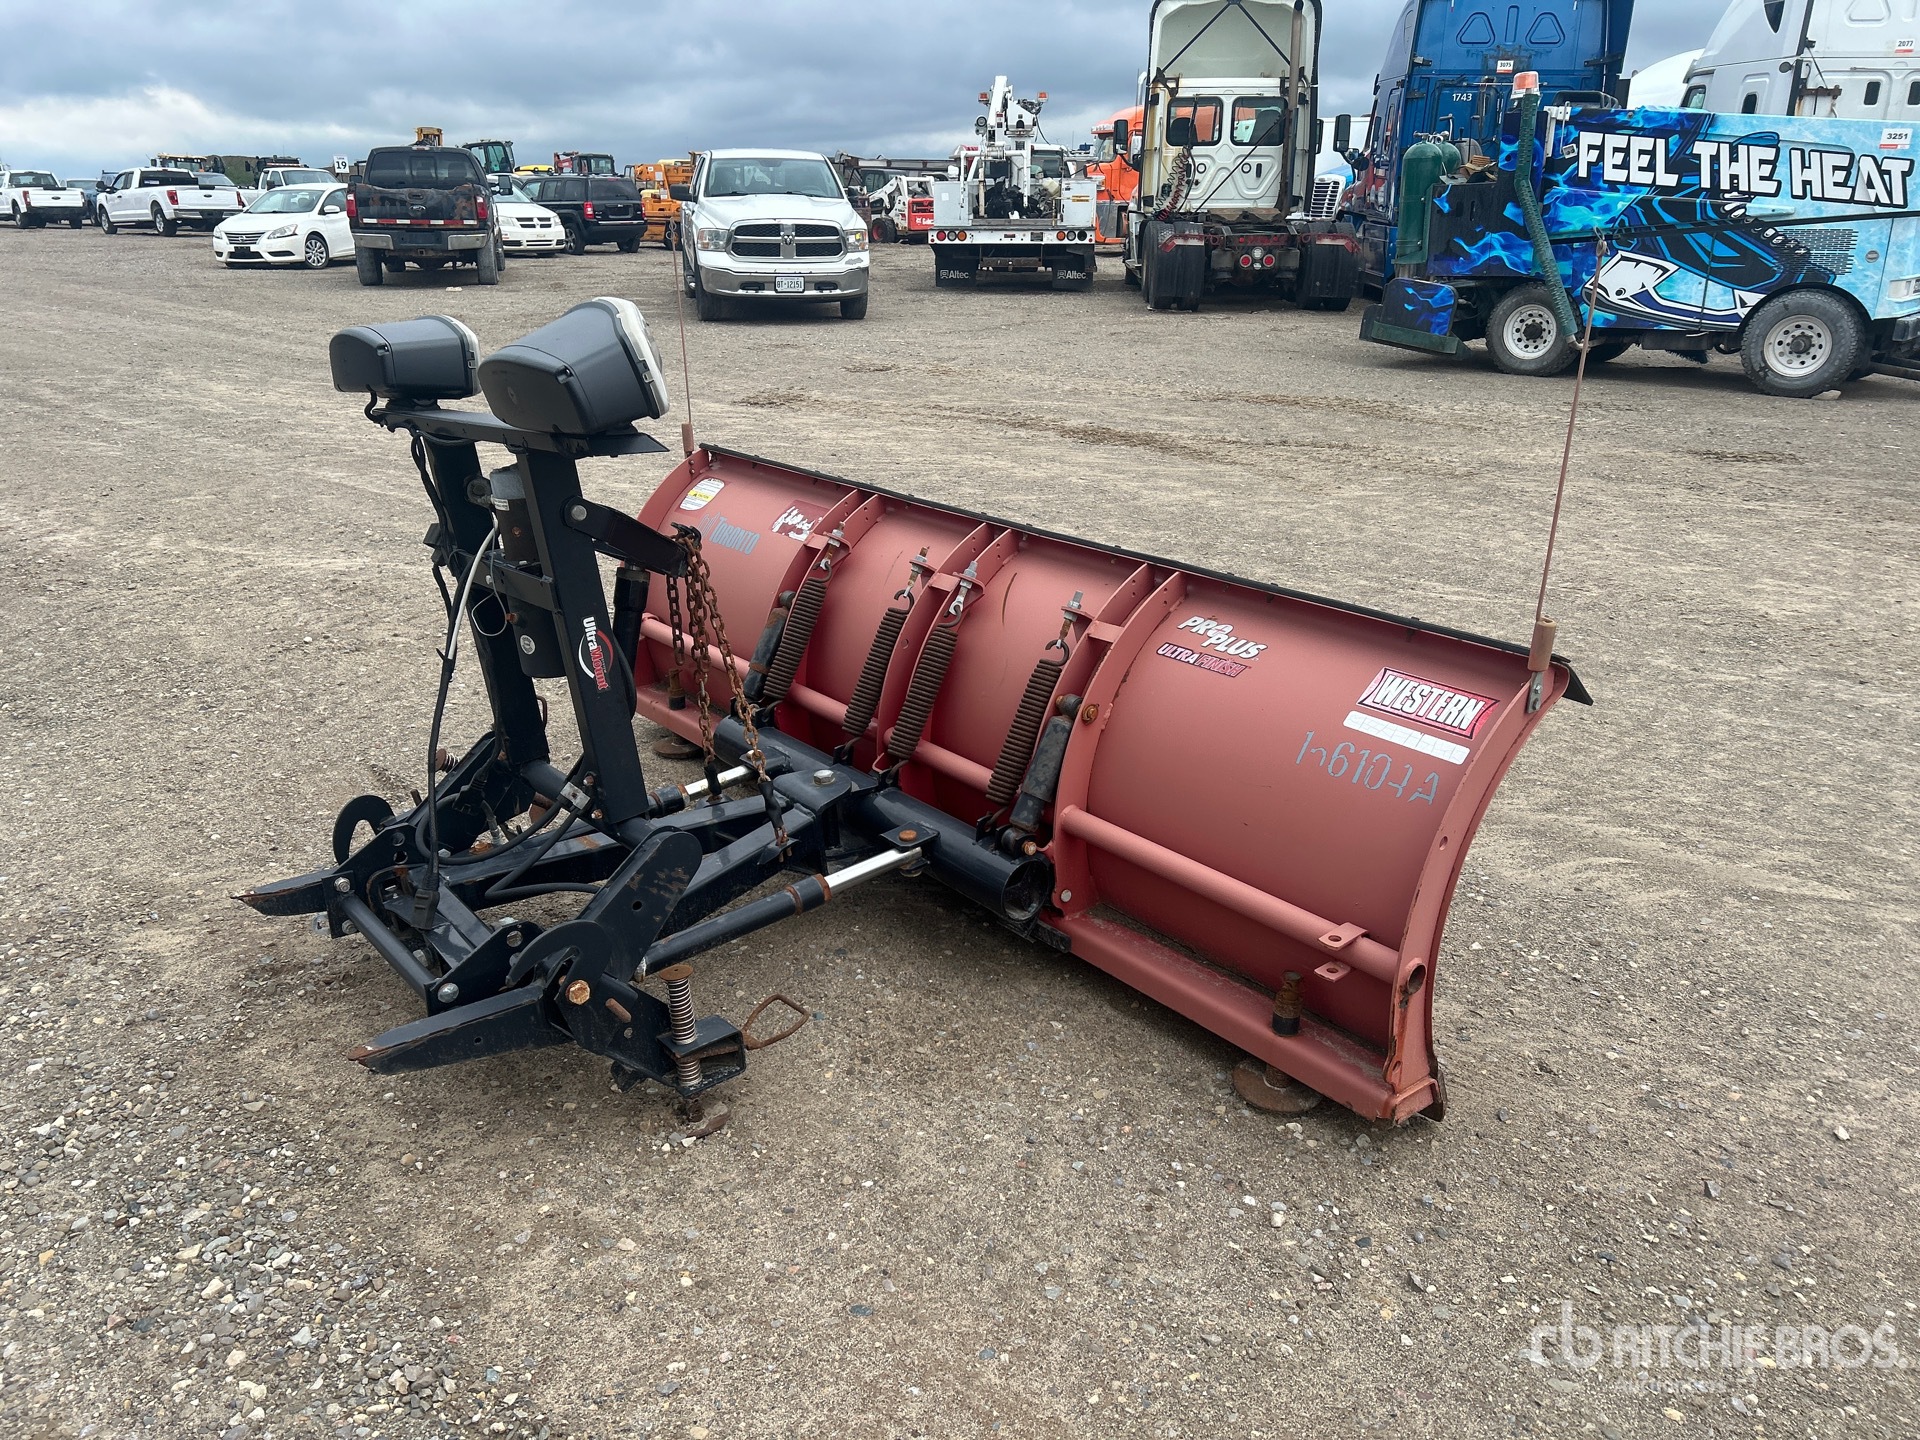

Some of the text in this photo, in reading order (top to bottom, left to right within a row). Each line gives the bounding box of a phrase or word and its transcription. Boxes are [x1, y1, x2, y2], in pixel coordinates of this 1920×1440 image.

[1452, 93, 1473, 102] 1743
[1886, 132, 1909, 140] 3251
[335, 160, 347, 170] 19
[1577, 131, 1915, 207] FEEL THE HEAT
[949, 270, 970, 279] Altec
[1066, 270, 1087, 279] Altec
[1176, 615, 1235, 638] PRO
[1200, 632, 1269, 659] PLUS
[1372, 673, 1487, 731] WESTERN
